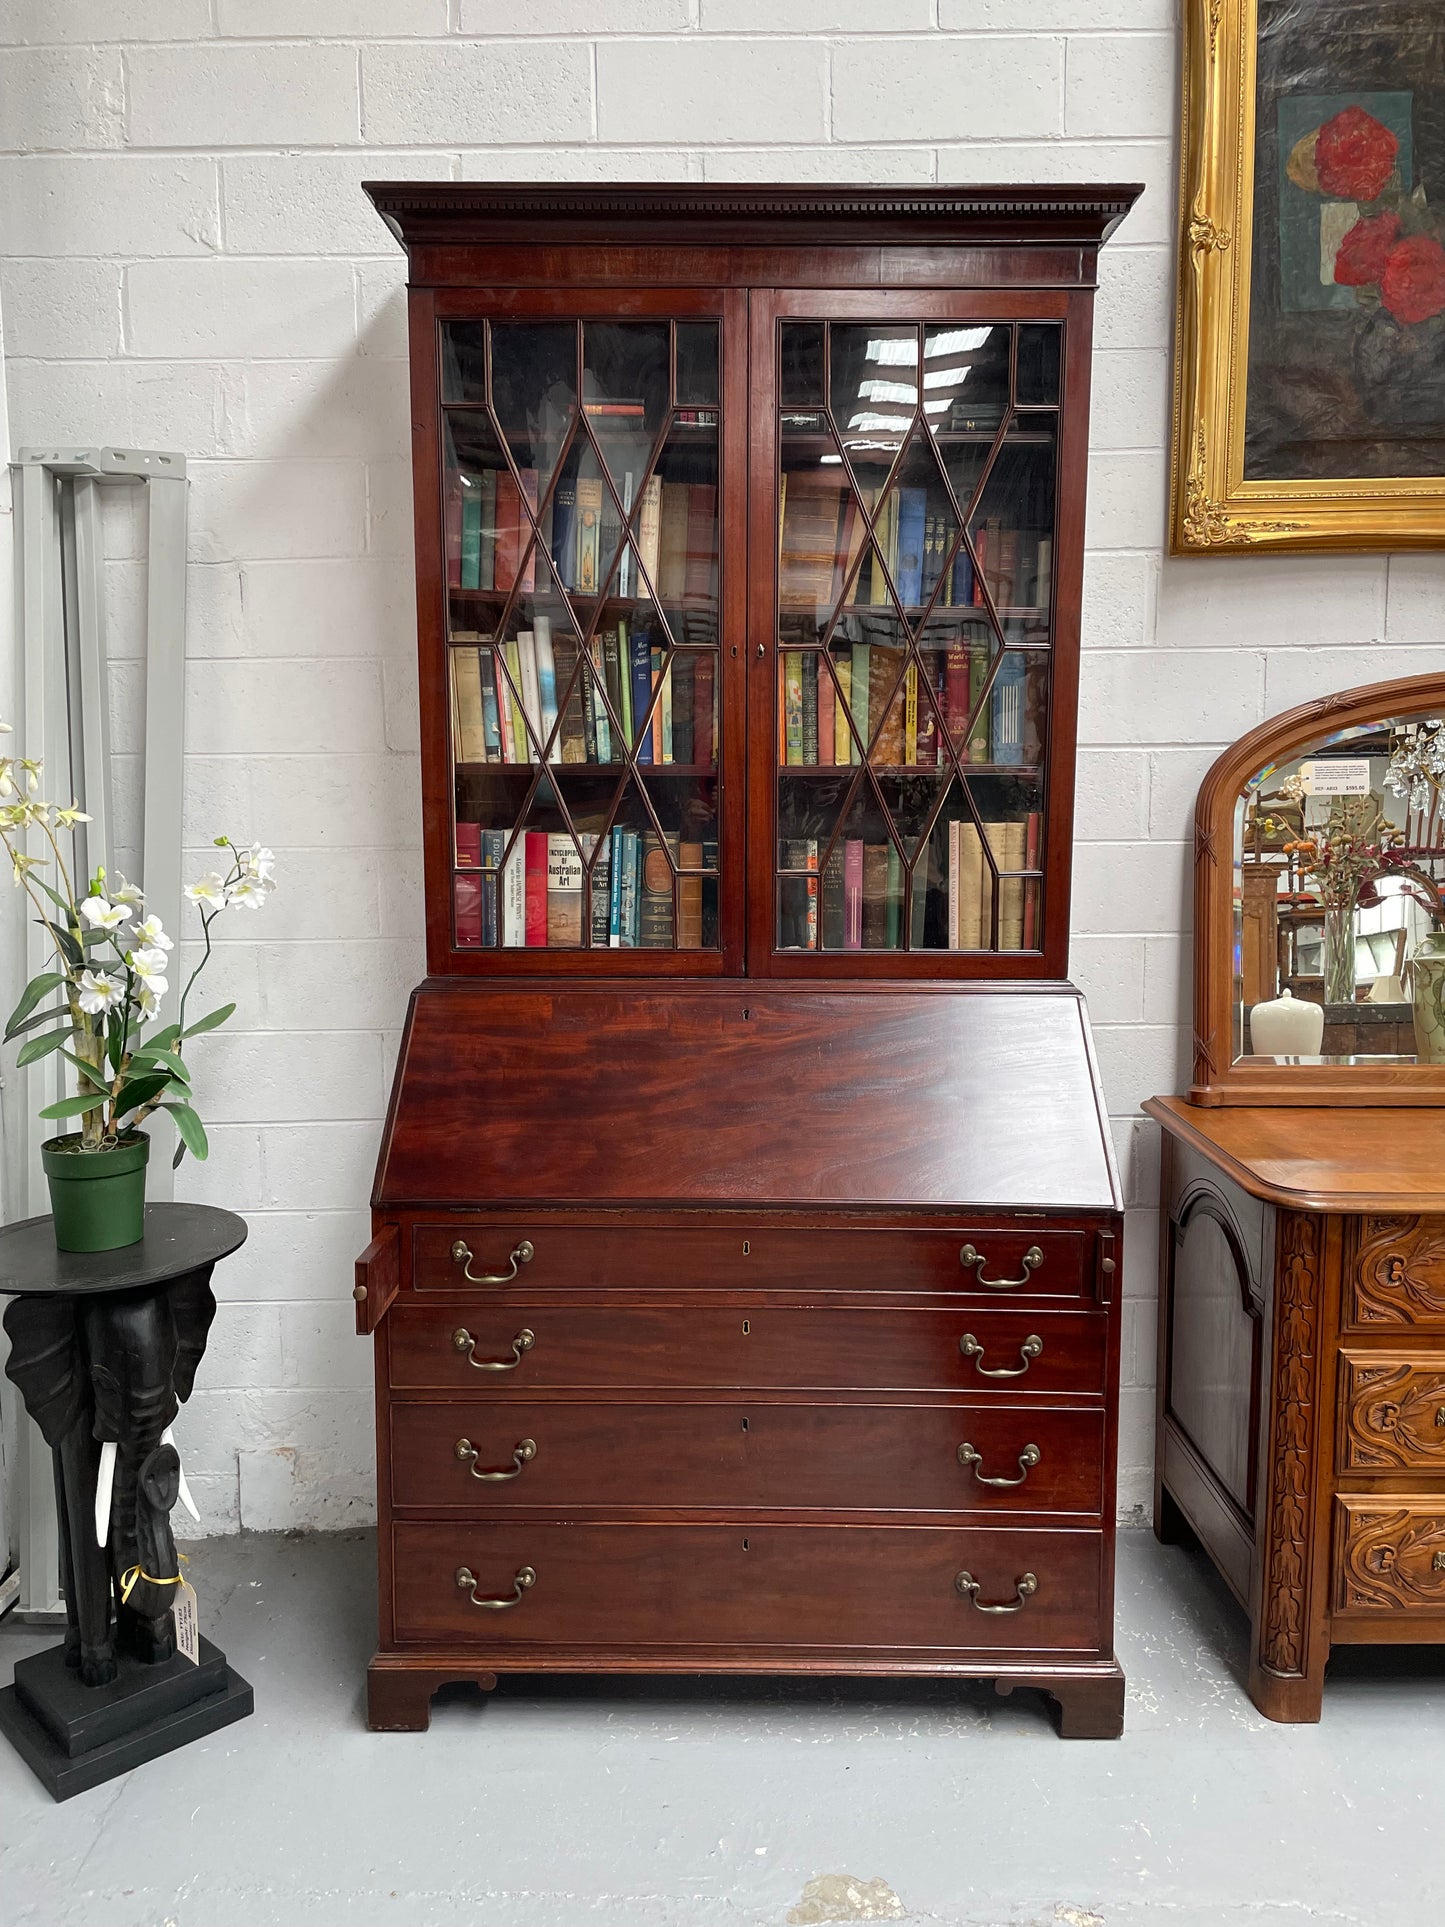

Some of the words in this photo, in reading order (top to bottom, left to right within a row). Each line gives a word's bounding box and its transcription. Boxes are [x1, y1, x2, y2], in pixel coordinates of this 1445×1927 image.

[585, 699, 593, 722] GENE
[549, 865, 581, 875] Australian
[558, 876, 570, 886] Art
